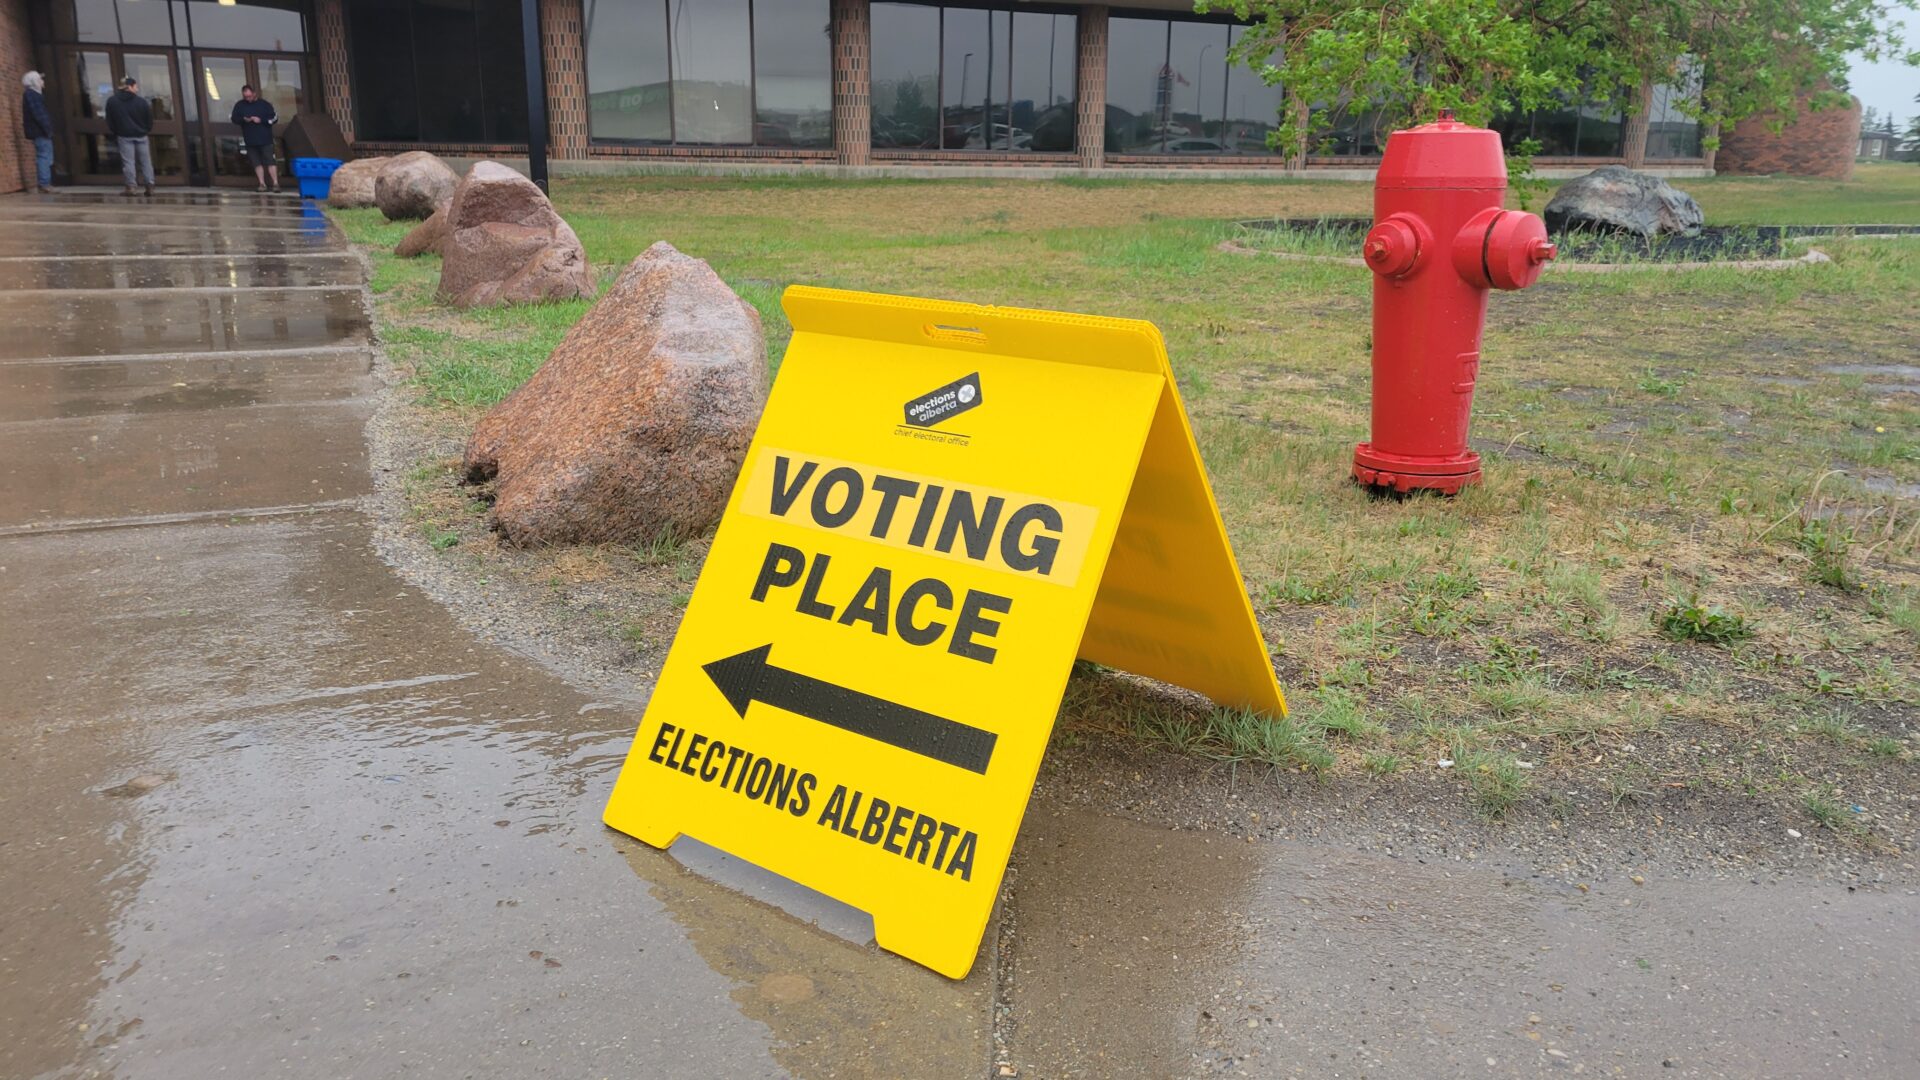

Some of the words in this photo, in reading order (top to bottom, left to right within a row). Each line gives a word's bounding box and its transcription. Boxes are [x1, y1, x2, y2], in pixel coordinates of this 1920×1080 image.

[894, 428, 913, 438] chief
[913, 432, 946, 443] electoral
[947, 437, 969, 447] office
[909, 391, 956, 416] elections
[919, 400, 957, 422] alberta
[770, 455, 1063, 576] VOTING
[750, 542, 1013, 665] PLACE
[648, 722, 818, 818] ELECTIONS
[817, 784, 978, 882] ALBERTA
